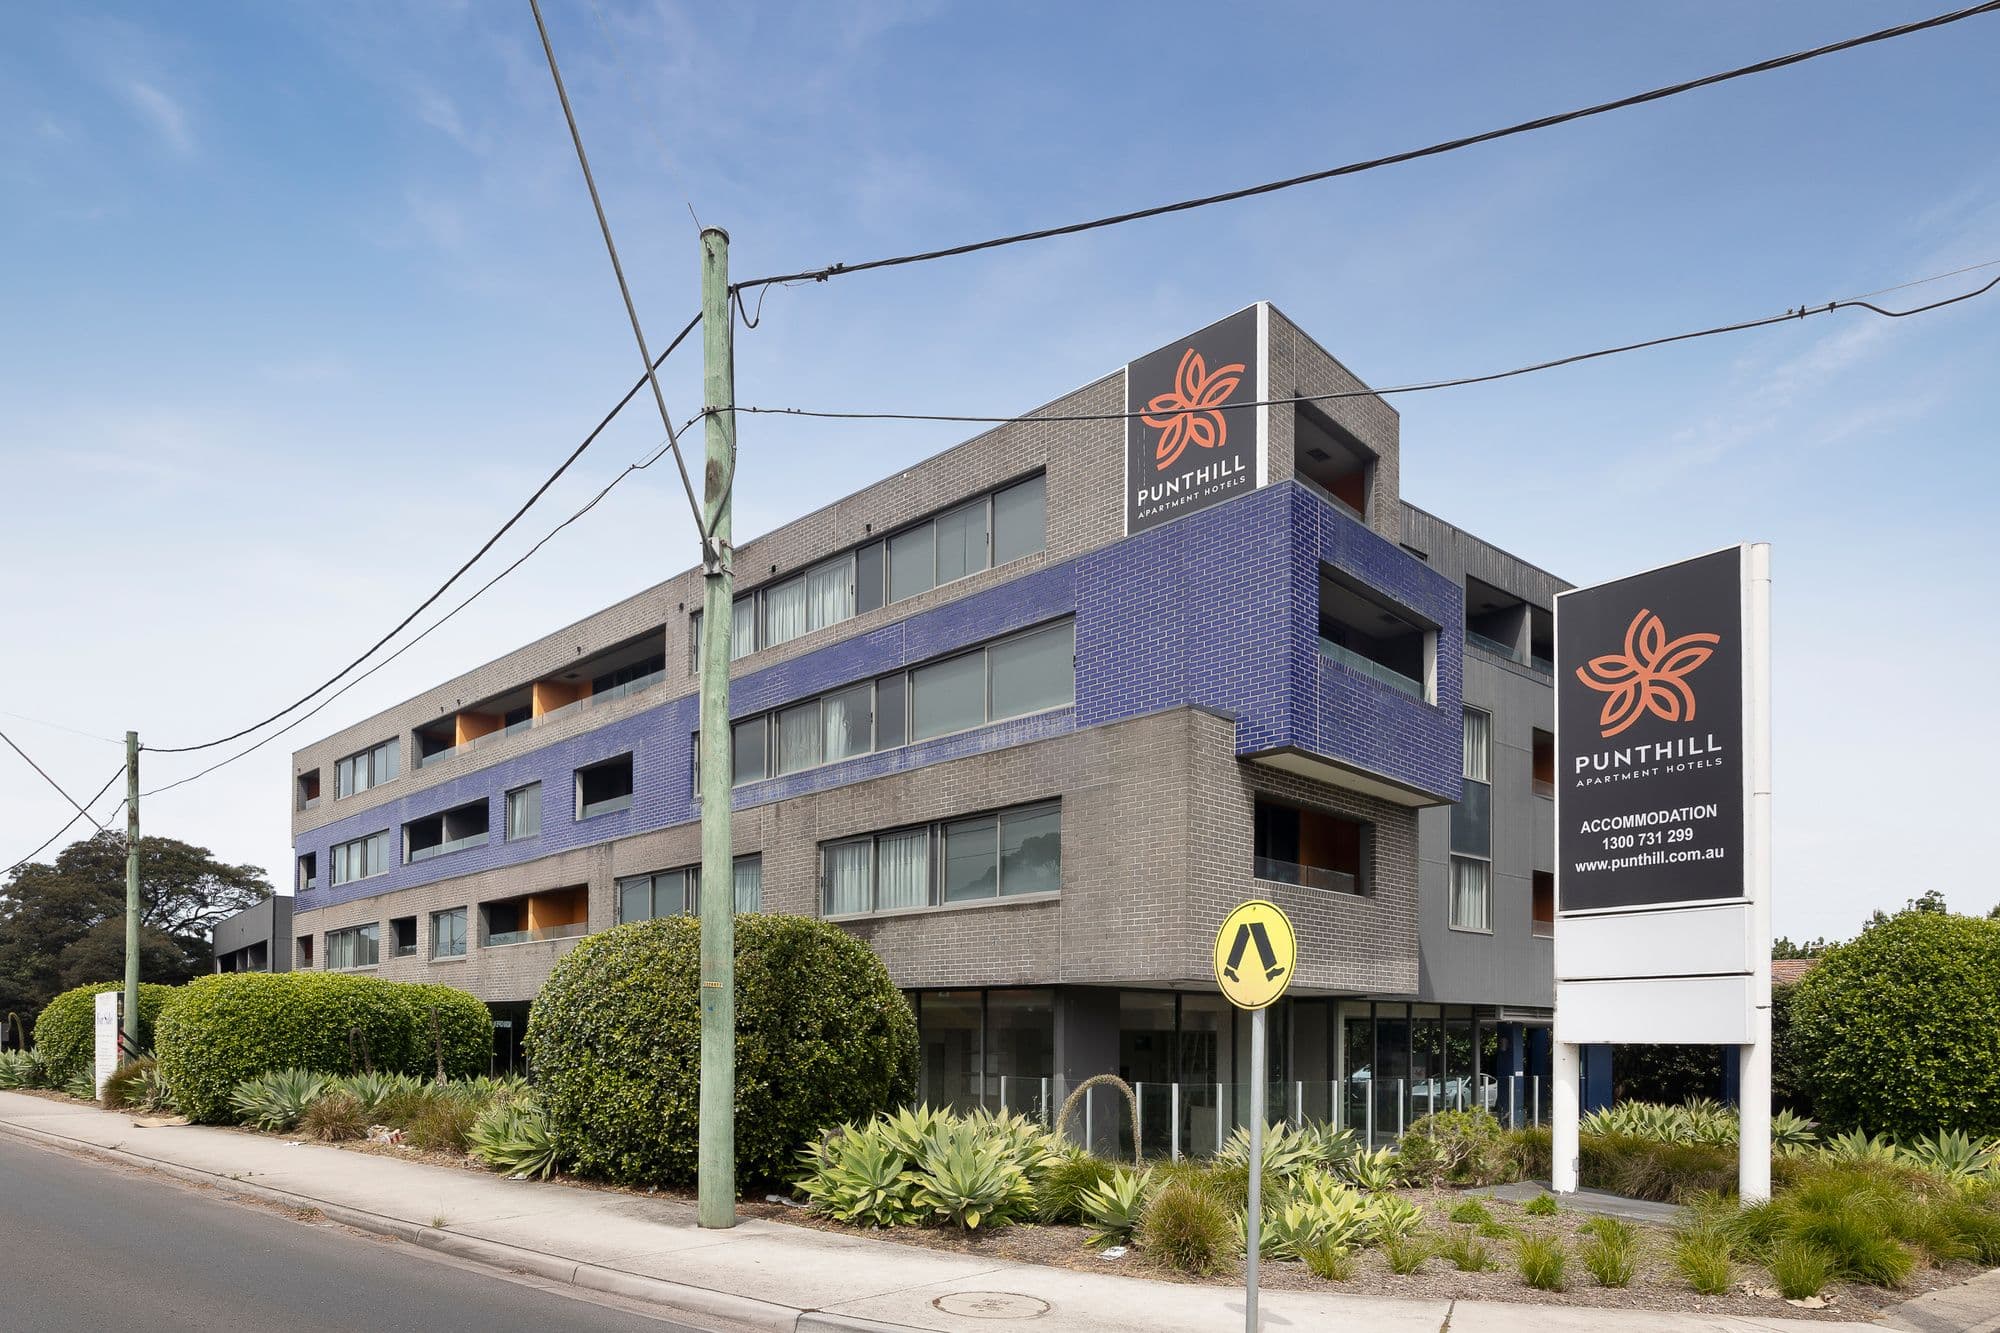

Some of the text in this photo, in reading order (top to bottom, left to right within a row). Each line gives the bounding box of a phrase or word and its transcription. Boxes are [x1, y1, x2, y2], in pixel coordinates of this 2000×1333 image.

[1138, 455, 1246, 507] PUNTHILL
[1138, 475, 1246, 519] APARTMENT HOTELS
[1575, 734, 1722, 774] PUNTHILL
[1576, 757, 1723, 787] APARTMENT HOTELS
[1580, 804, 1718, 834] ACCOMMODATION
[1602, 827, 1694, 850] 1300 731 299
[1575, 847, 1724, 872] www.punthill.com.au
